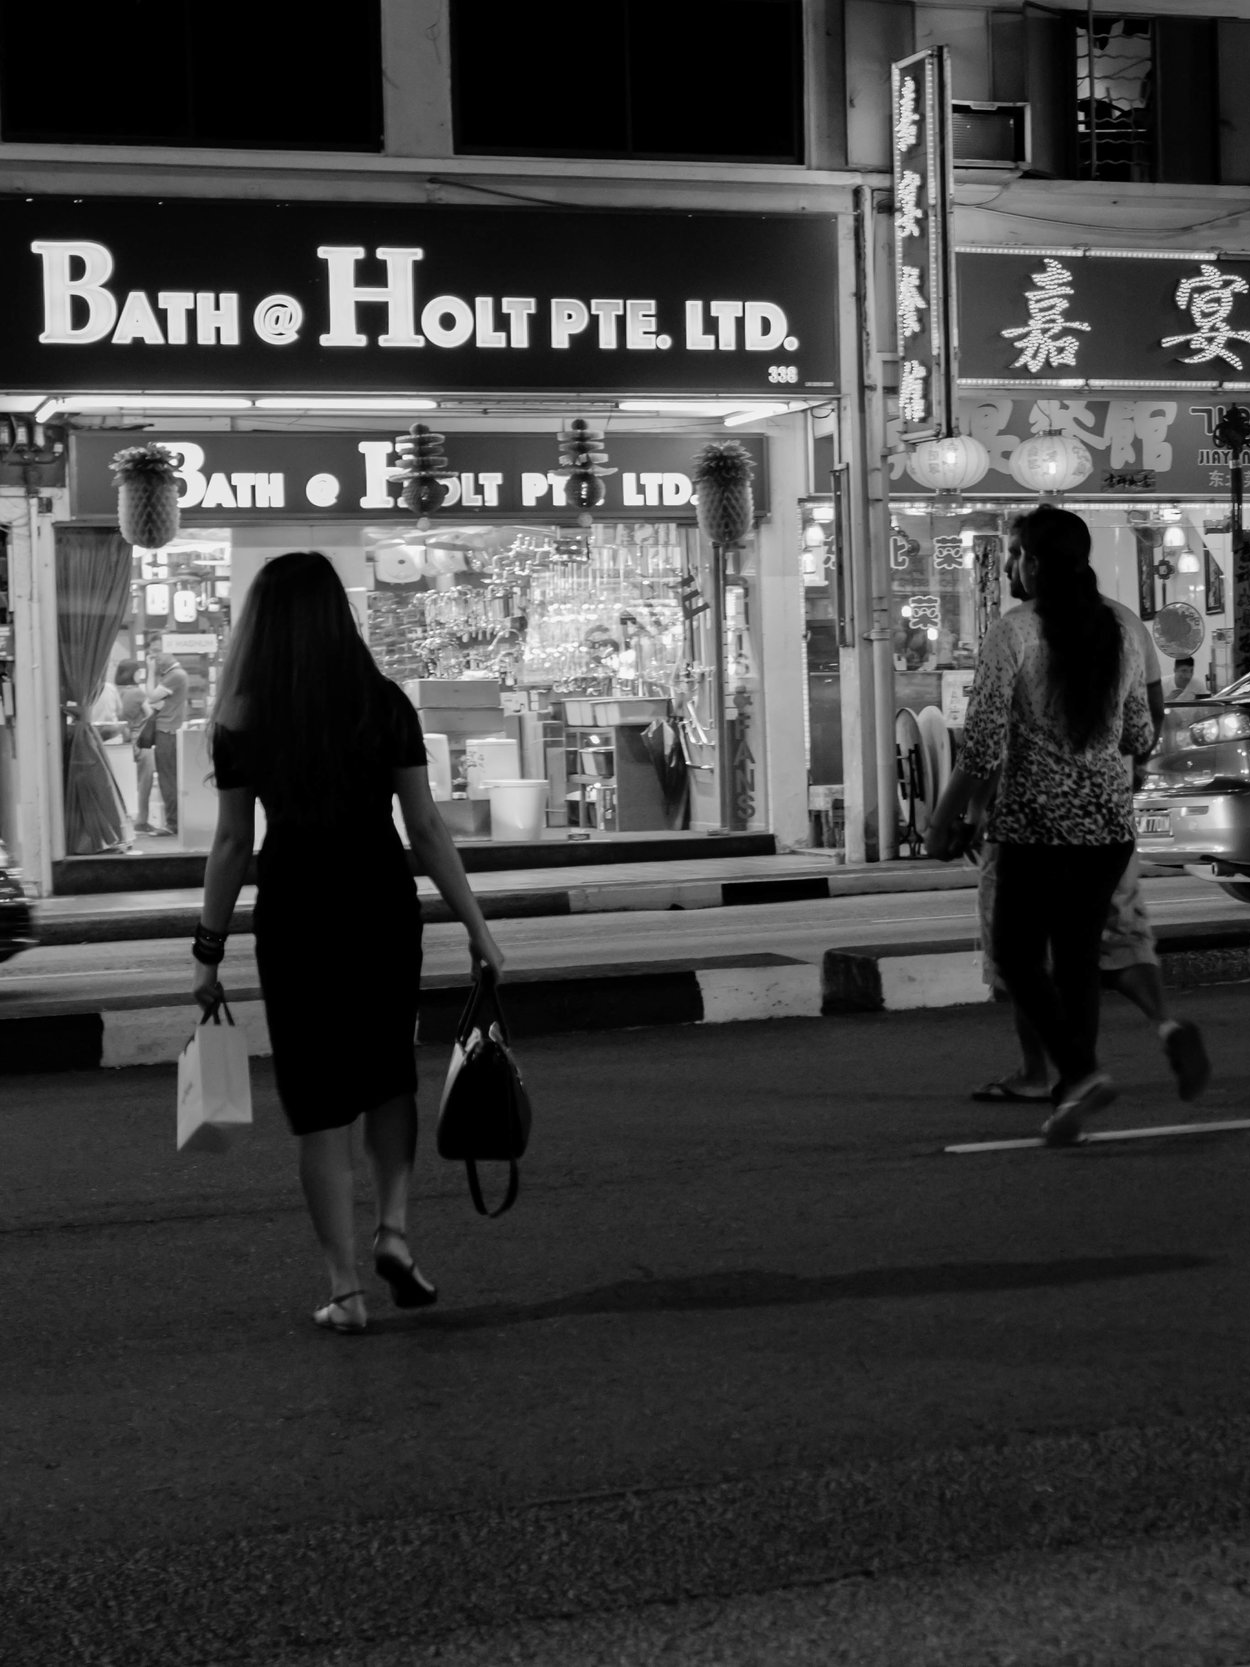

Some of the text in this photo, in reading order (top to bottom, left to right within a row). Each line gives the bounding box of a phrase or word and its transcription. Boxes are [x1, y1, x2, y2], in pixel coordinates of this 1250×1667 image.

[31, 240, 800, 351] BATH @ HOLT PTE. LTD.
[735, 711, 756, 820] FANS
